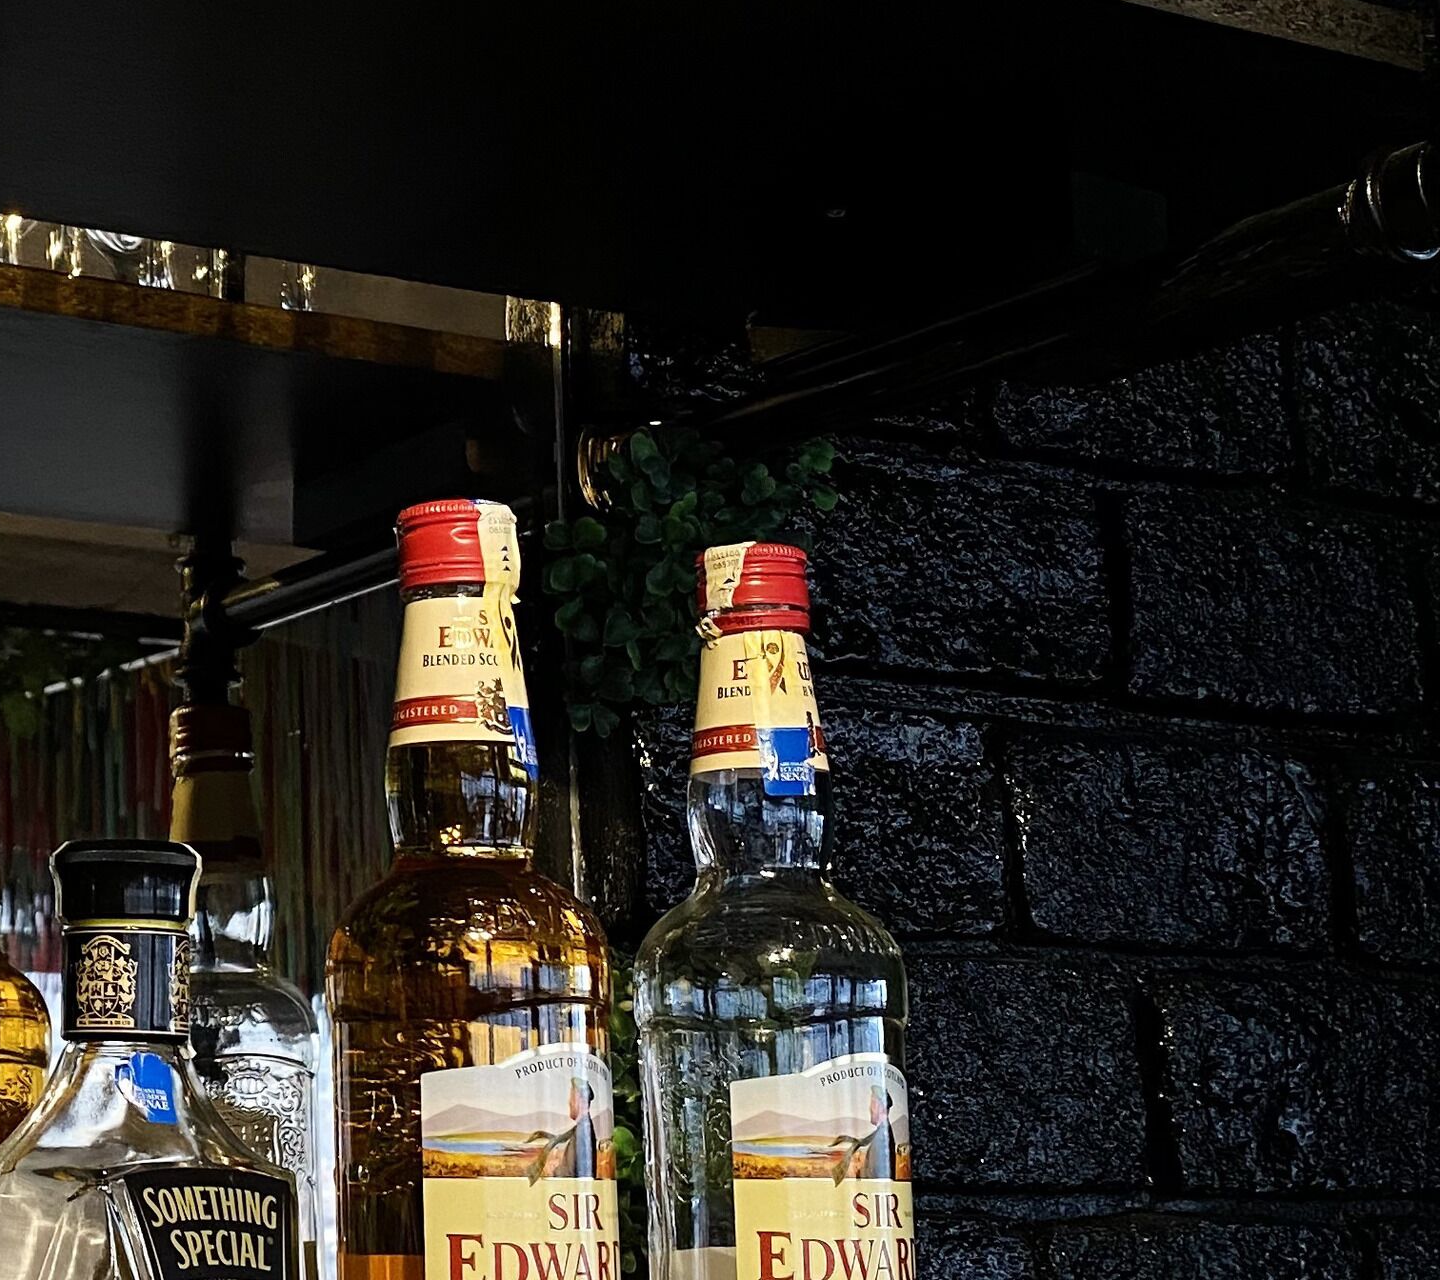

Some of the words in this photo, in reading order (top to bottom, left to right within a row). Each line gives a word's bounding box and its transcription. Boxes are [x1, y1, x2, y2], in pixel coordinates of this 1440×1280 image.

[423, 654, 475, 667] BLENDED
[717, 686, 751, 699] BLEND
[515, 1058, 564, 1078] PRODUCT
[820, 1067, 864, 1086] PRODUCT
[143, 1186, 277, 1229] SOMETHING
[548, 1193, 603, 1230] SIR
[853, 1192, 903, 1229] SIR
[170, 1230, 272, 1271] SPECIAL
